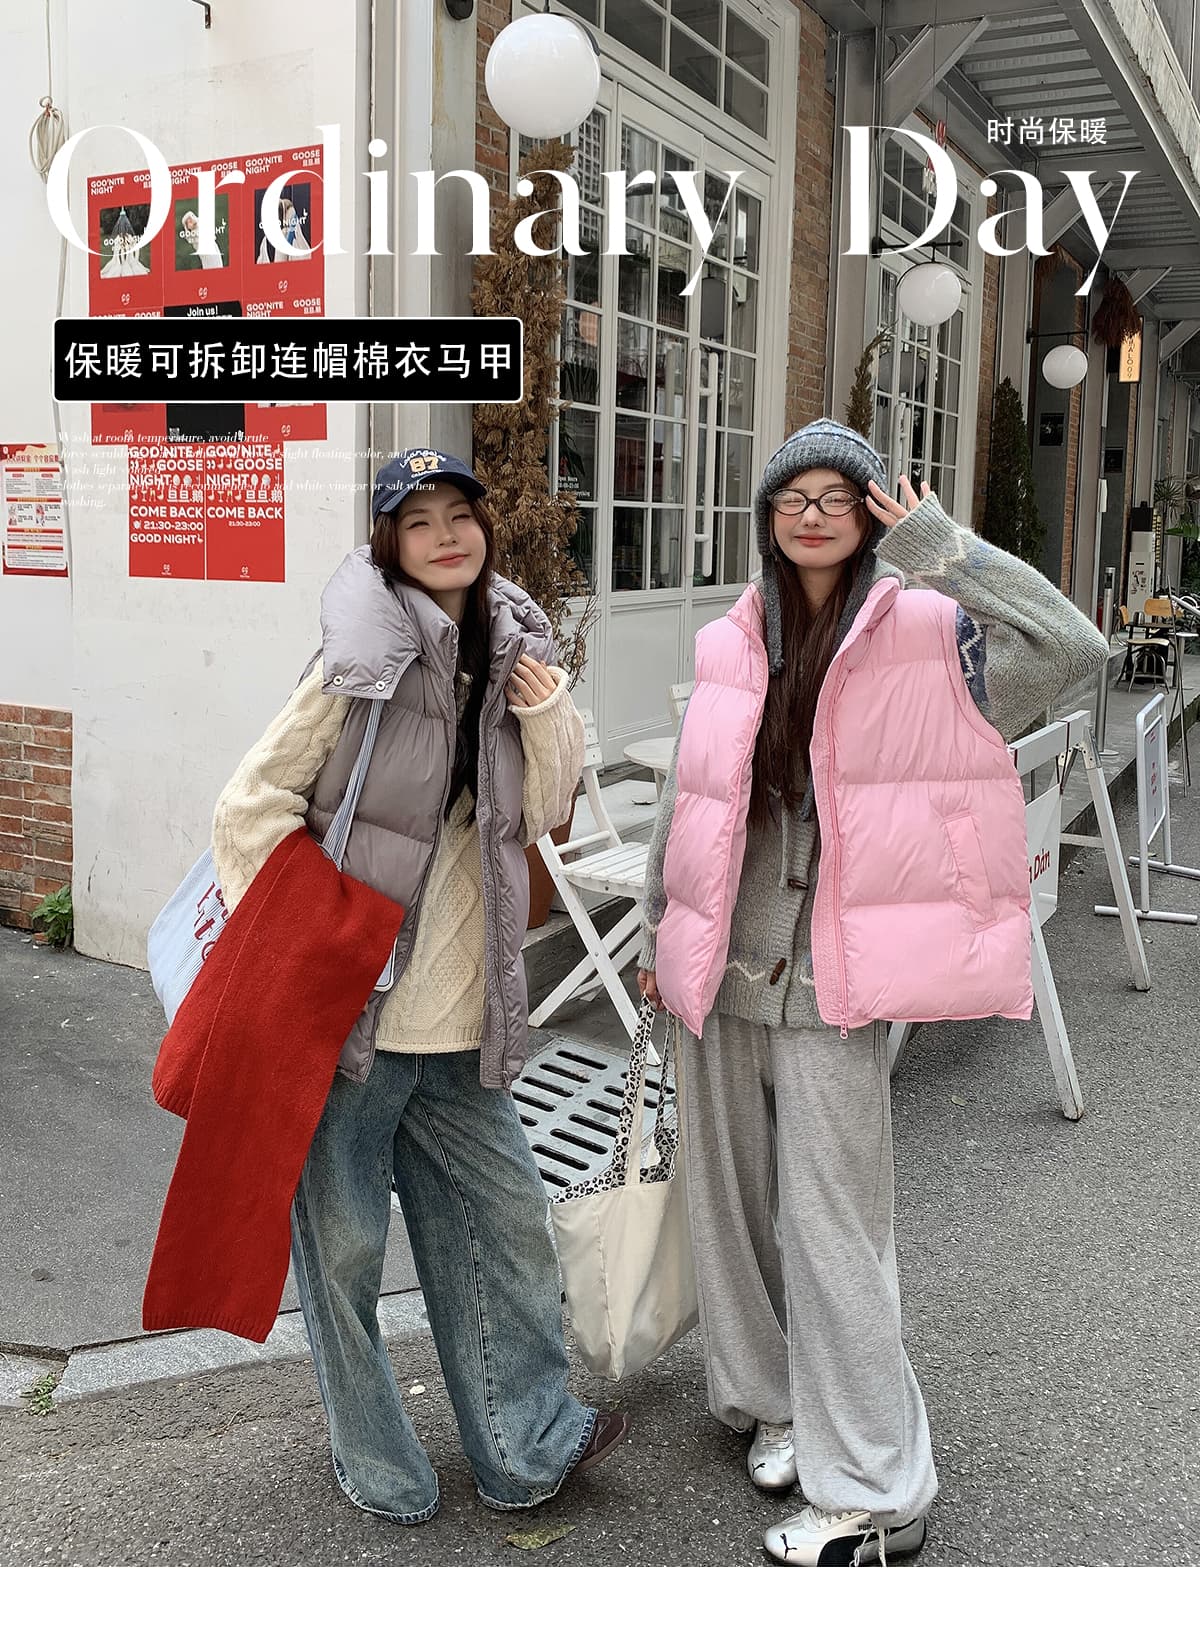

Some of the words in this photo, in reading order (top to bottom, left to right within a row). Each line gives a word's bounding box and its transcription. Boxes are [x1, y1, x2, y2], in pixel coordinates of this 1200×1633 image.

[245, 155, 283, 167] GOO'NITE
[292, 149, 321, 161] GOOSE
[245, 165, 270, 175] NIGHT
[91, 177, 125, 188] GOO'NITE
[172, 176, 190, 185] IGHT
[91, 186, 114, 196] NIGHT
[187, 307, 204, 317] Join
[205, 305, 219, 316] us!
[246, 301, 284, 312] GOO'NITE
[293, 298, 321, 308] GOOSE
[157, 459, 204, 471] GOOSE
[234, 458, 283, 470] GOOSE
[409, 456, 440, 473] 87
[130, 473, 171, 486] NIGHT
[206, 473, 249, 486] NIGHT
[131, 506, 166, 518] COME
[170, 507, 204, 519] BACK
[207, 506, 245, 519] COME
[248, 507, 283, 519] BACK
[143, 520, 204, 531] 21:30-23:00
[130, 533, 161, 543] GOOD
[163, 534, 196, 544] NIGHT
